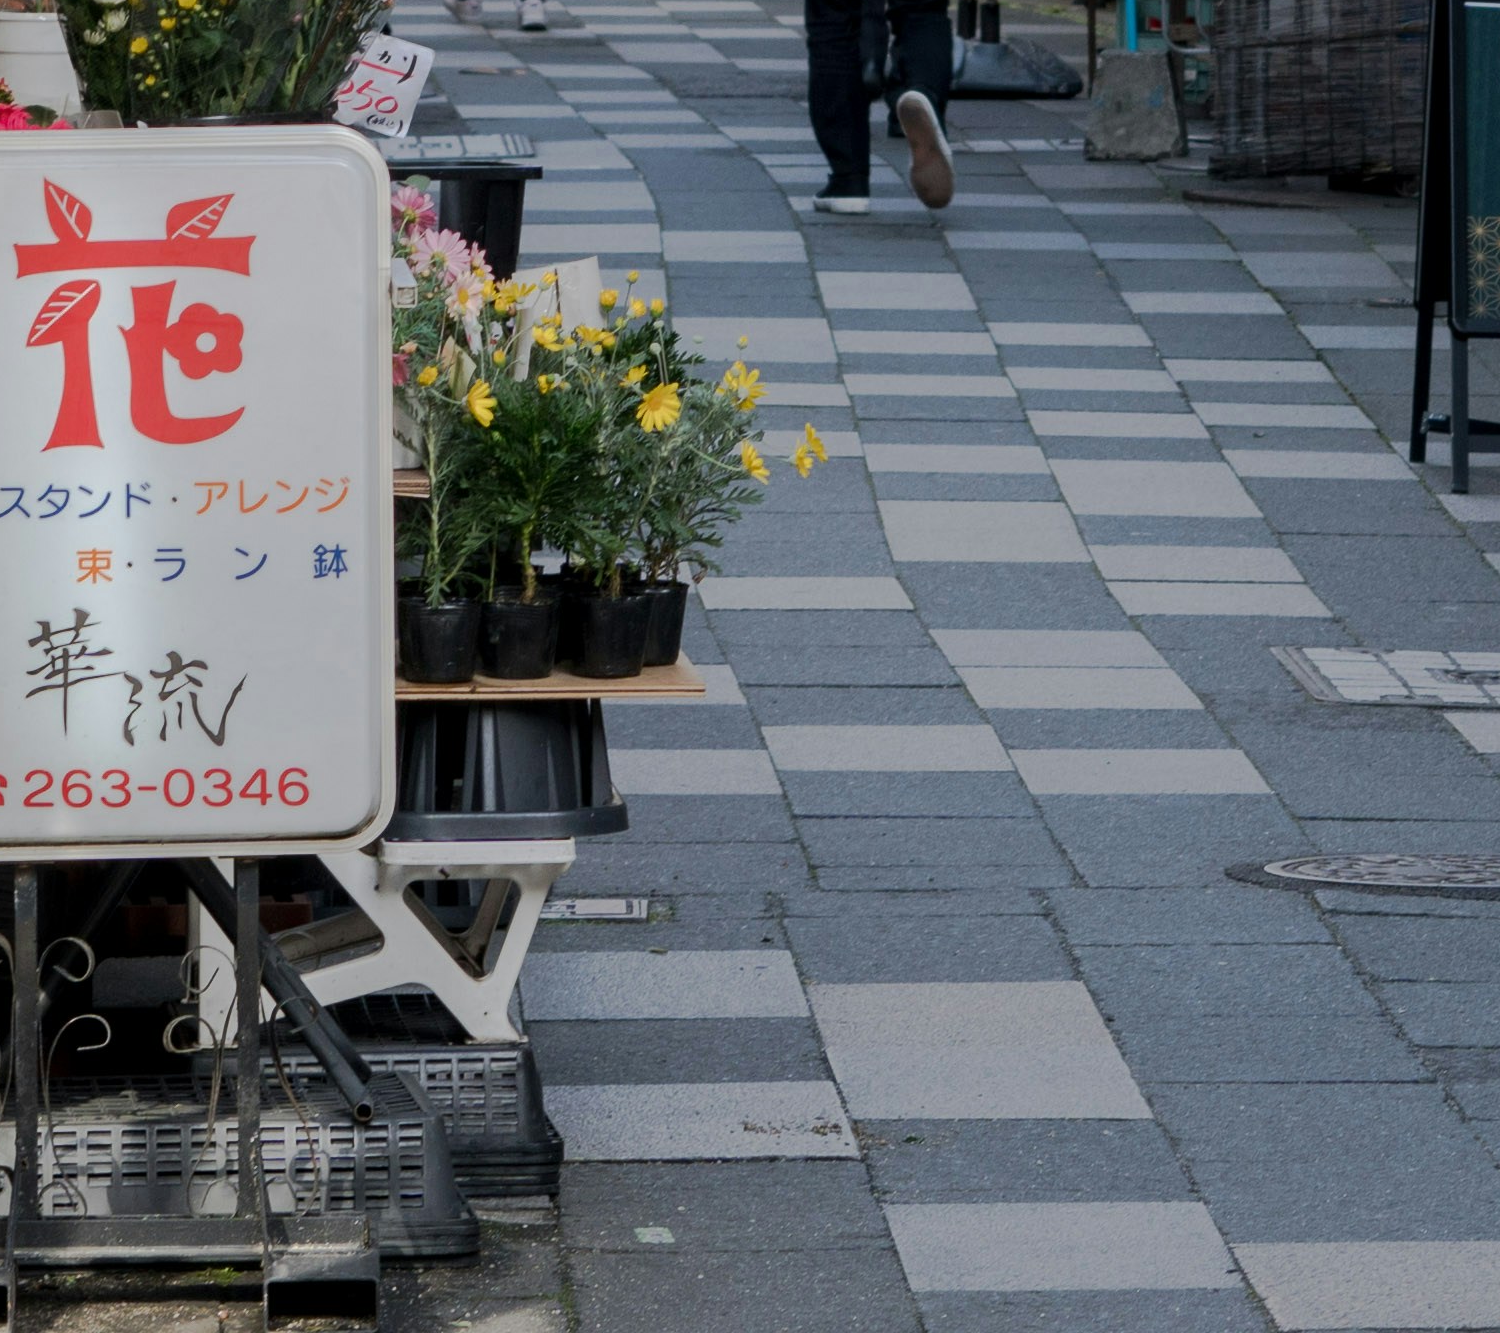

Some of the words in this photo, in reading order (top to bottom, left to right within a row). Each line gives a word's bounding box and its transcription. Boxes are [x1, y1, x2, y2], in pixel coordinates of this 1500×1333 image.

[13, 177, 257, 453] 花
[26, 608, 248, 747] 華流
[22, 768, 311, 809] 263-0346
